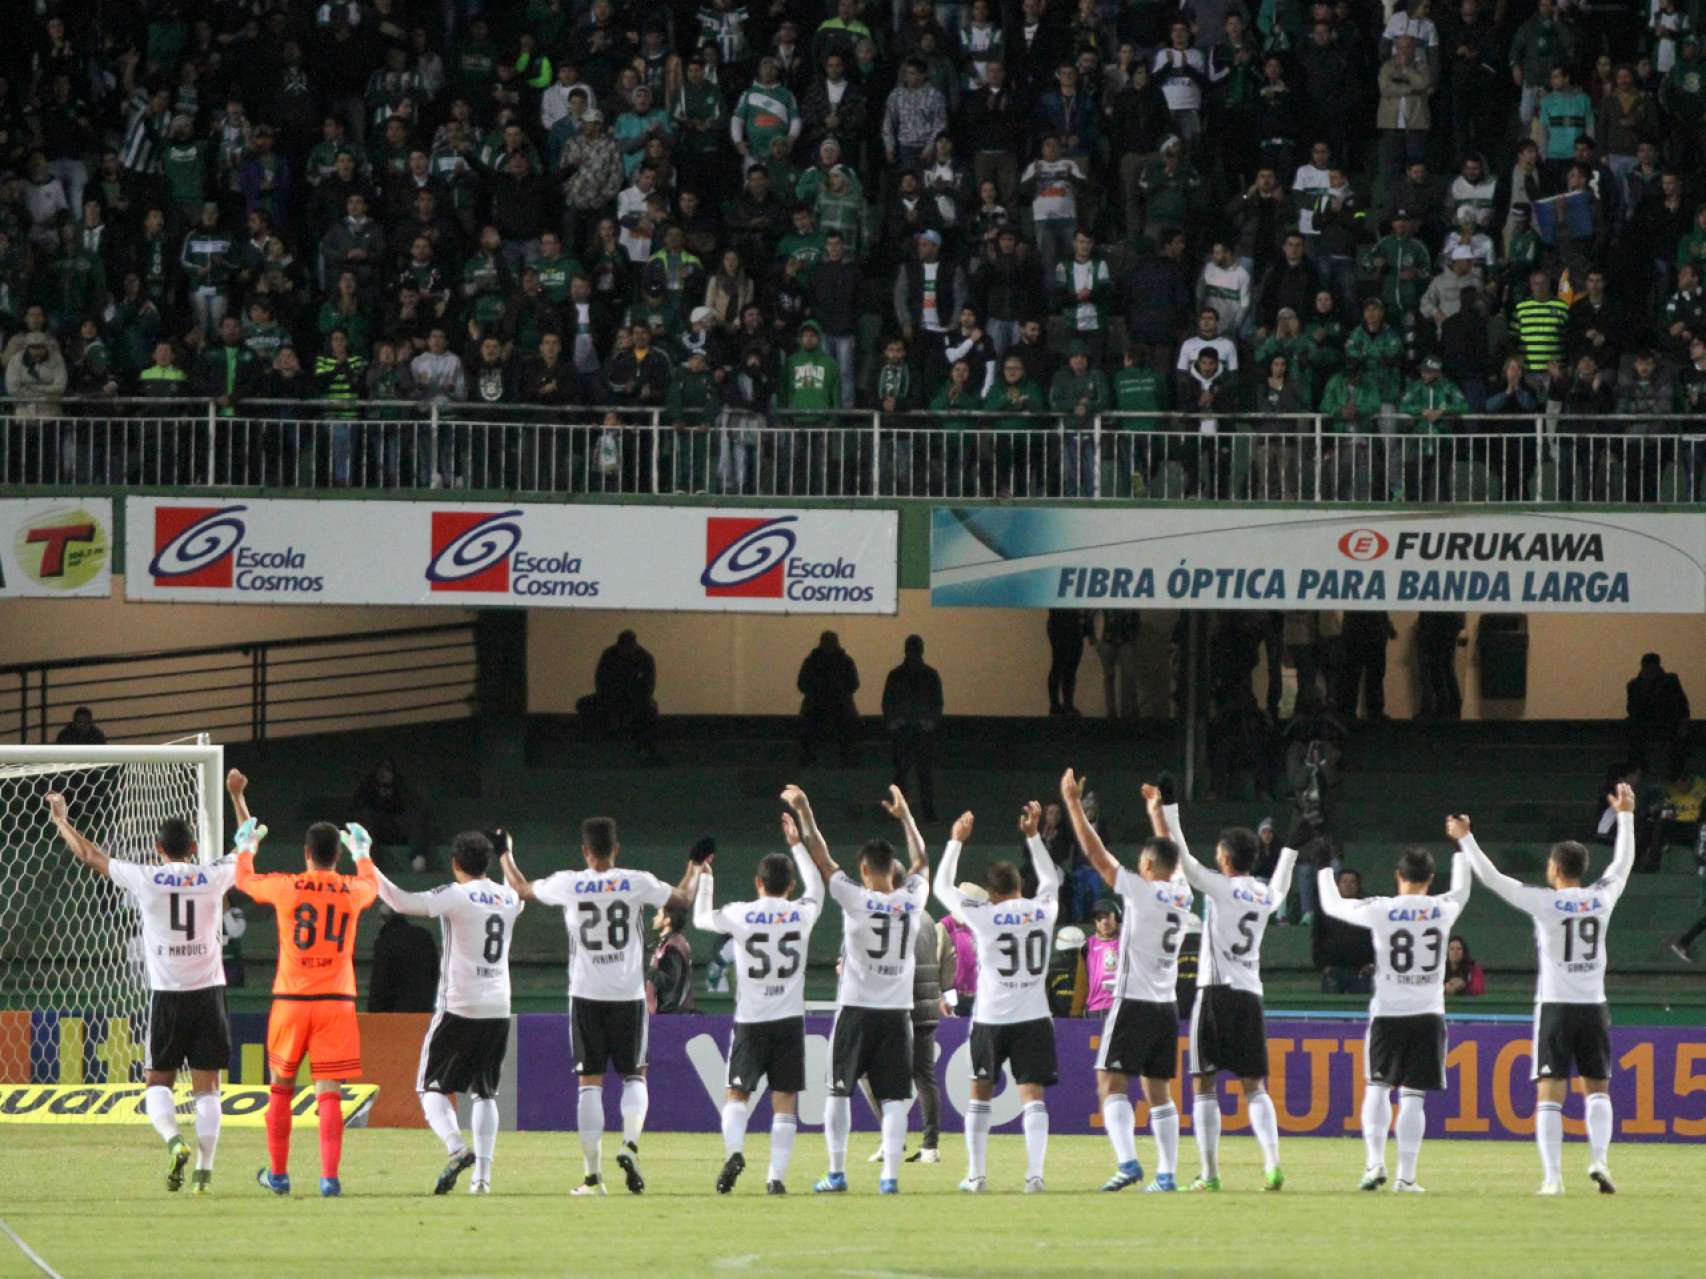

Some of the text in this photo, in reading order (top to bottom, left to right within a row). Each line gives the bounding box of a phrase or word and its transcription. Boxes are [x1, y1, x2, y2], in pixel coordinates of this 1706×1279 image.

[1395, 531, 1604, 561] FURUKAWA
[236, 547, 305, 569] Escola
[512, 552, 580, 573] Escola
[787, 557, 855, 579] Escola
[236, 571, 324, 592] Cosmos
[512, 576, 599, 597] Cosmos
[787, 580, 874, 602] Cosmos
[1057, 559, 1629, 603] FIBRA ÓPTICA PARA BANDA LARGA
[154, 872, 208, 887] CAIXA
[295, 879, 350, 895] CAIXA
[575, 879, 631, 894] CAIXA
[469, 891, 513, 907] CAIXA
[867, 899, 914, 913] CAIXA
[1555, 900, 1601, 914] CAIXA
[170, 893, 195, 941] 4
[578, 900, 630, 951] 28
[745, 911, 800, 925] CAIXA
[993, 909, 1045, 926] CAIXA
[1388, 907, 1441, 922] CAIXA
[294, 902, 350, 953] 84
[483, 913, 505, 964] 8
[867, 912, 910, 960] 31
[1162, 912, 1181, 953] 2
[1231, 911, 1259, 955] 5
[1390, 927, 1443, 973] 83
[1562, 916, 1600, 962] 19
[169, 944, 208, 957] MARQUES
[746, 930, 800, 979] 55
[997, 929, 1048, 976] 30
